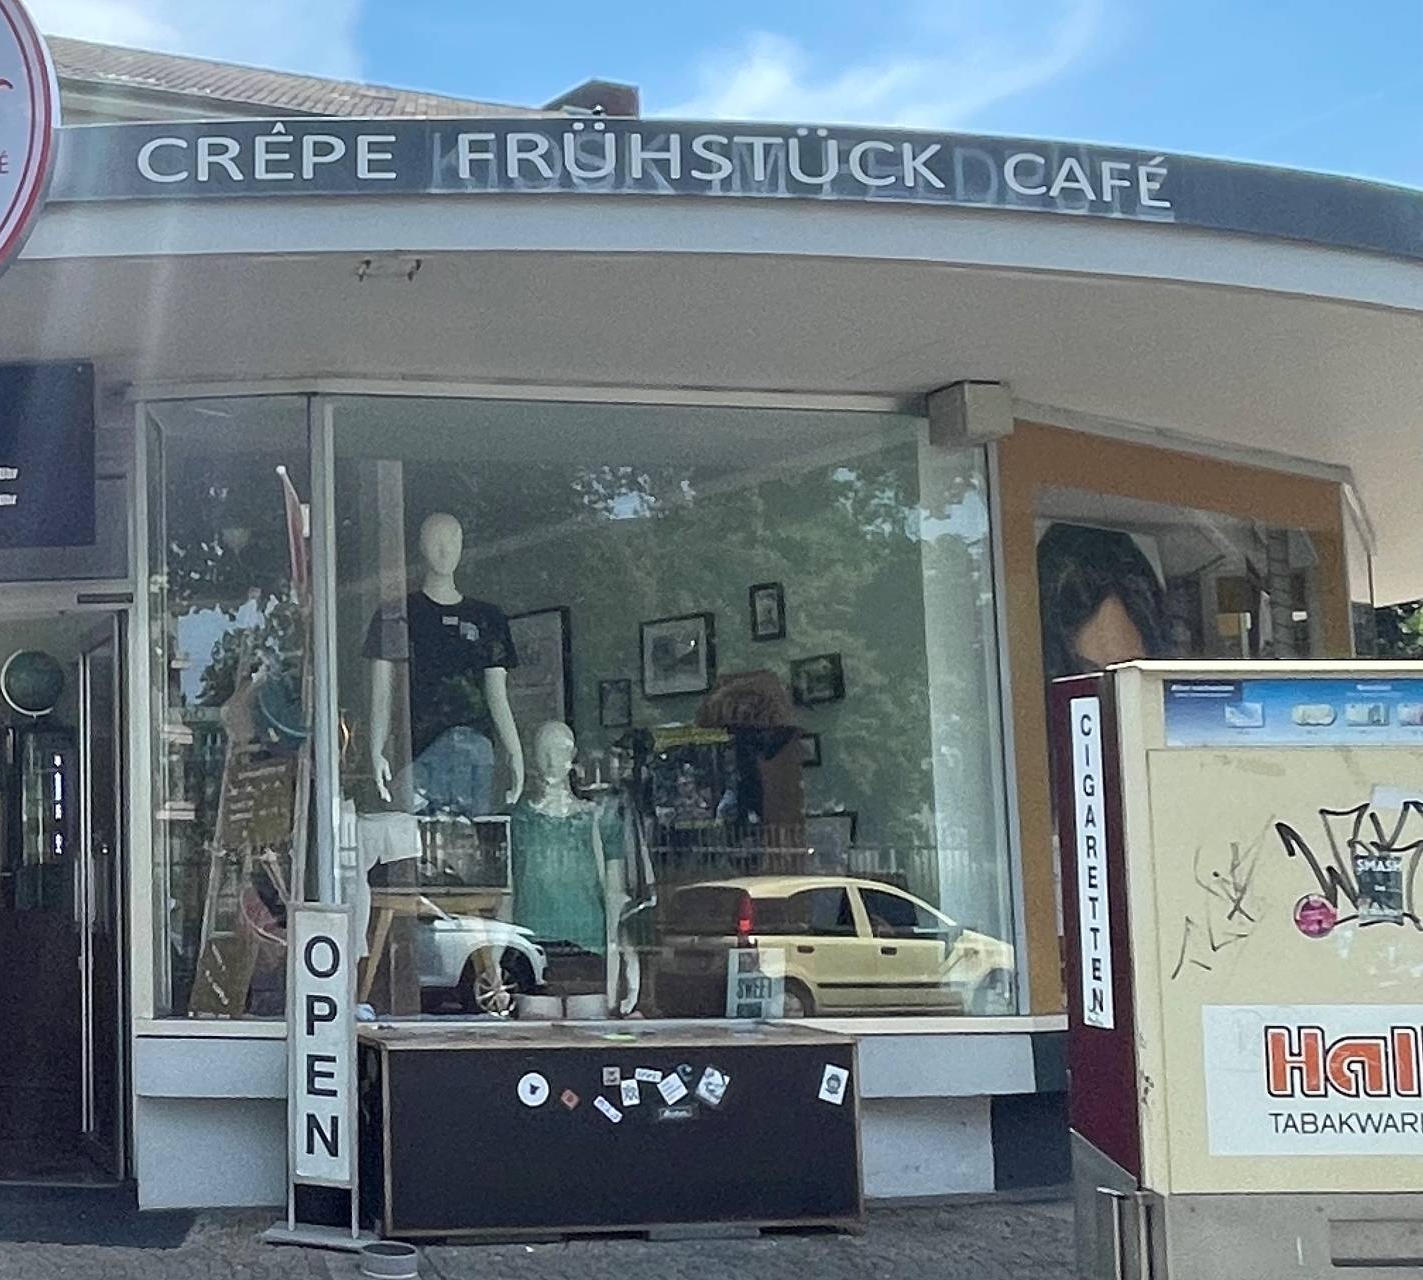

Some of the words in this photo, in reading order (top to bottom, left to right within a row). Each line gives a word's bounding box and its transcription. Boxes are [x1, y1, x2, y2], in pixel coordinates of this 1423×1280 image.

[136, 121, 398, 183] CRÊPE
[457, 121, 946, 190] FRÜHSTÜCK
[1002, 154, 1172, 209] CAFÉ
[1079, 713, 1105, 1014] CIGARETTEN
[303, 934, 341, 1159] OPEN
[1264, 1025, 1423, 1098] Hal
[1268, 1112, 1423, 1134] TABAKWAR
